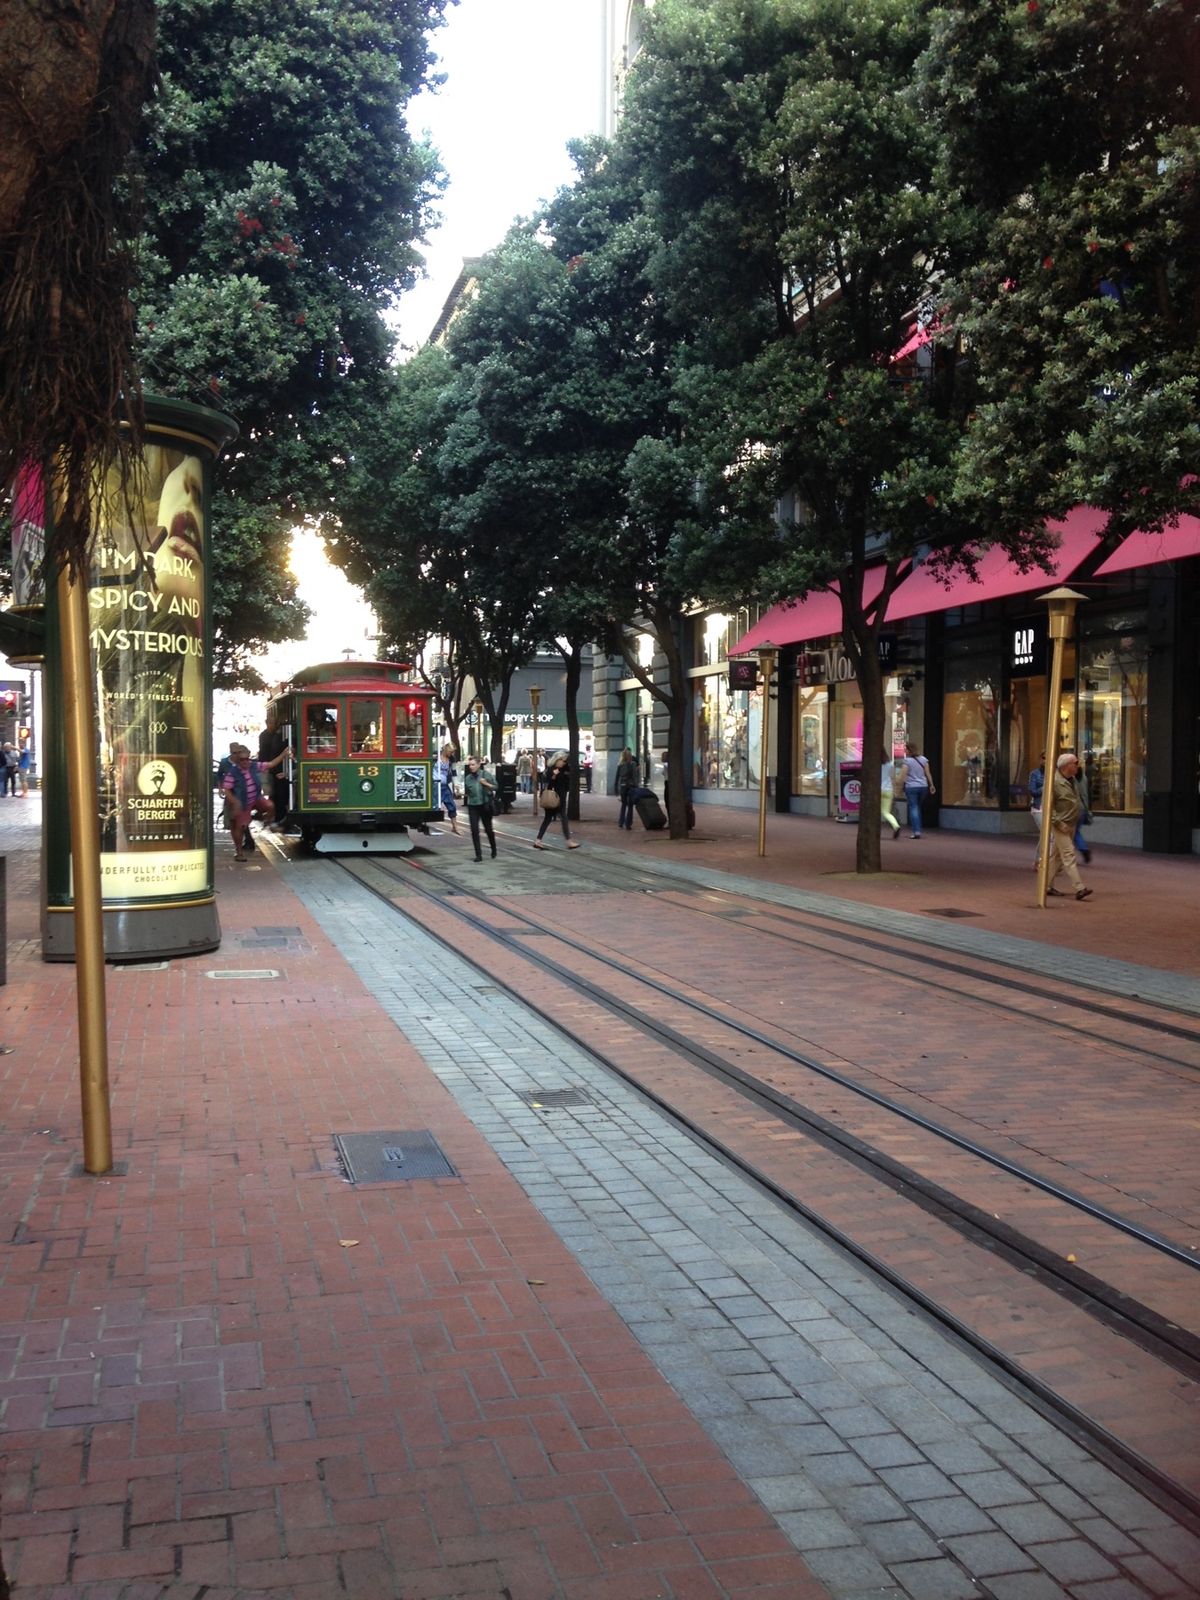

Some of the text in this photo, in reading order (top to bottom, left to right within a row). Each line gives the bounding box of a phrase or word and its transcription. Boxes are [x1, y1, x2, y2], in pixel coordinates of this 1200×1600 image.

[101, 548, 196, 582] I'M DARK,
[89, 588, 199, 618] SPICY AND
[1015, 629, 1034, 655] GAP
[1015, 656, 1033, 665] BODY
[108, 692, 144, 700] WORLD'S
[504, 713, 529, 722] BODY
[358, 766, 379, 776] 13
[128, 798, 184, 809] SCHARFFEN
[138, 810, 176, 821] BERGER
